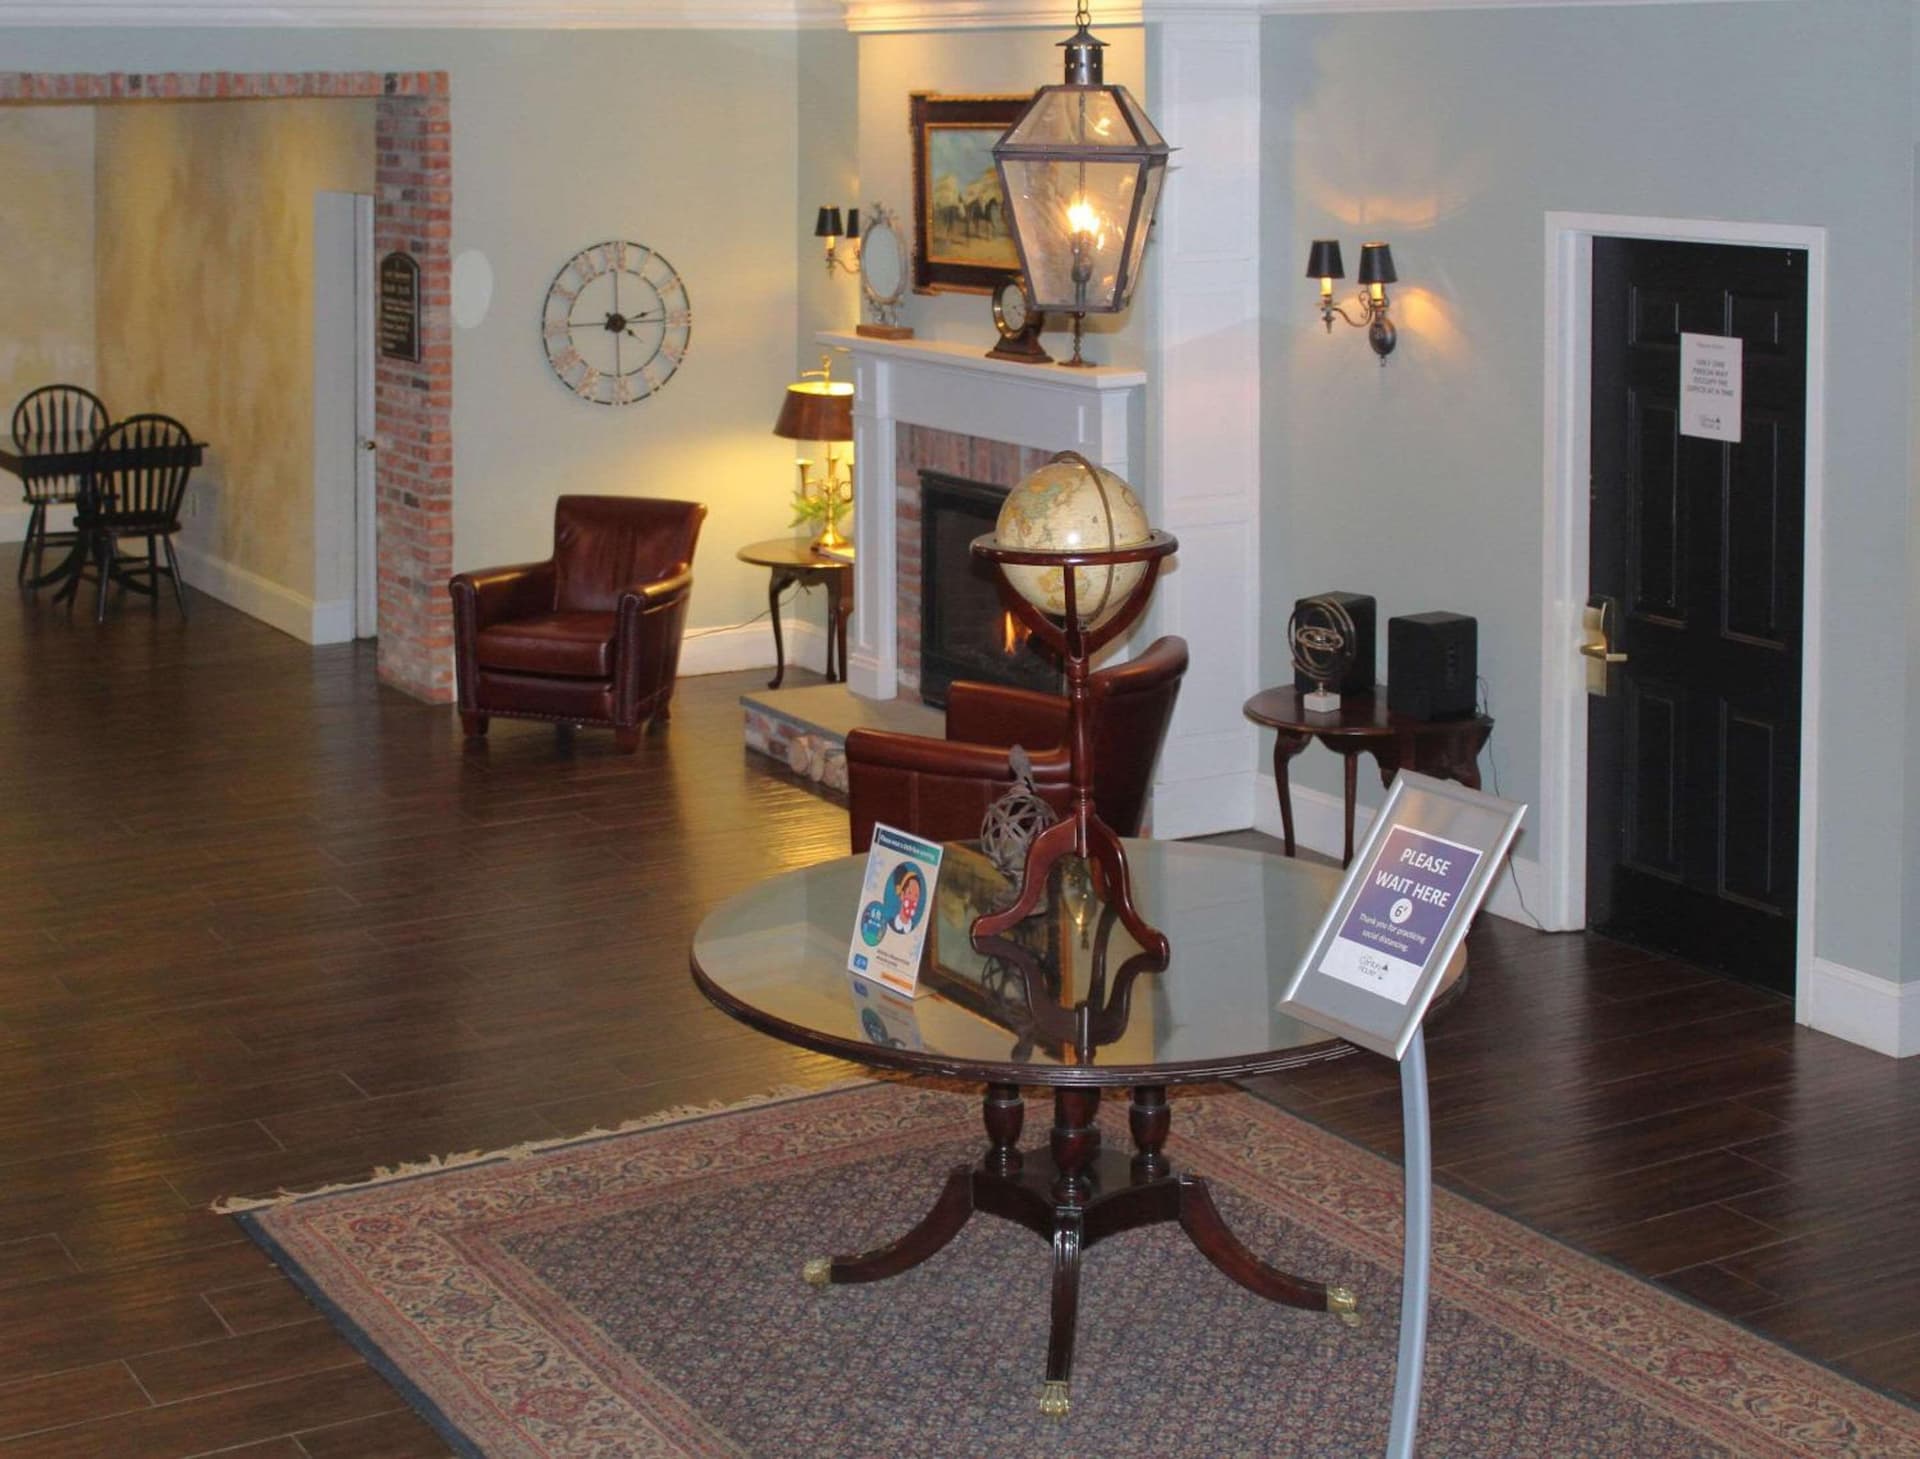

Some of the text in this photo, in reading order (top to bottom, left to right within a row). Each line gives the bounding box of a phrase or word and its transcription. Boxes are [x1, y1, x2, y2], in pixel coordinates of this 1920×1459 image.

[1400, 848, 1452, 876] PLEASE
[1375, 870, 1452, 908] WAIT HERE
[1360, 912, 1376, 924] Thank
